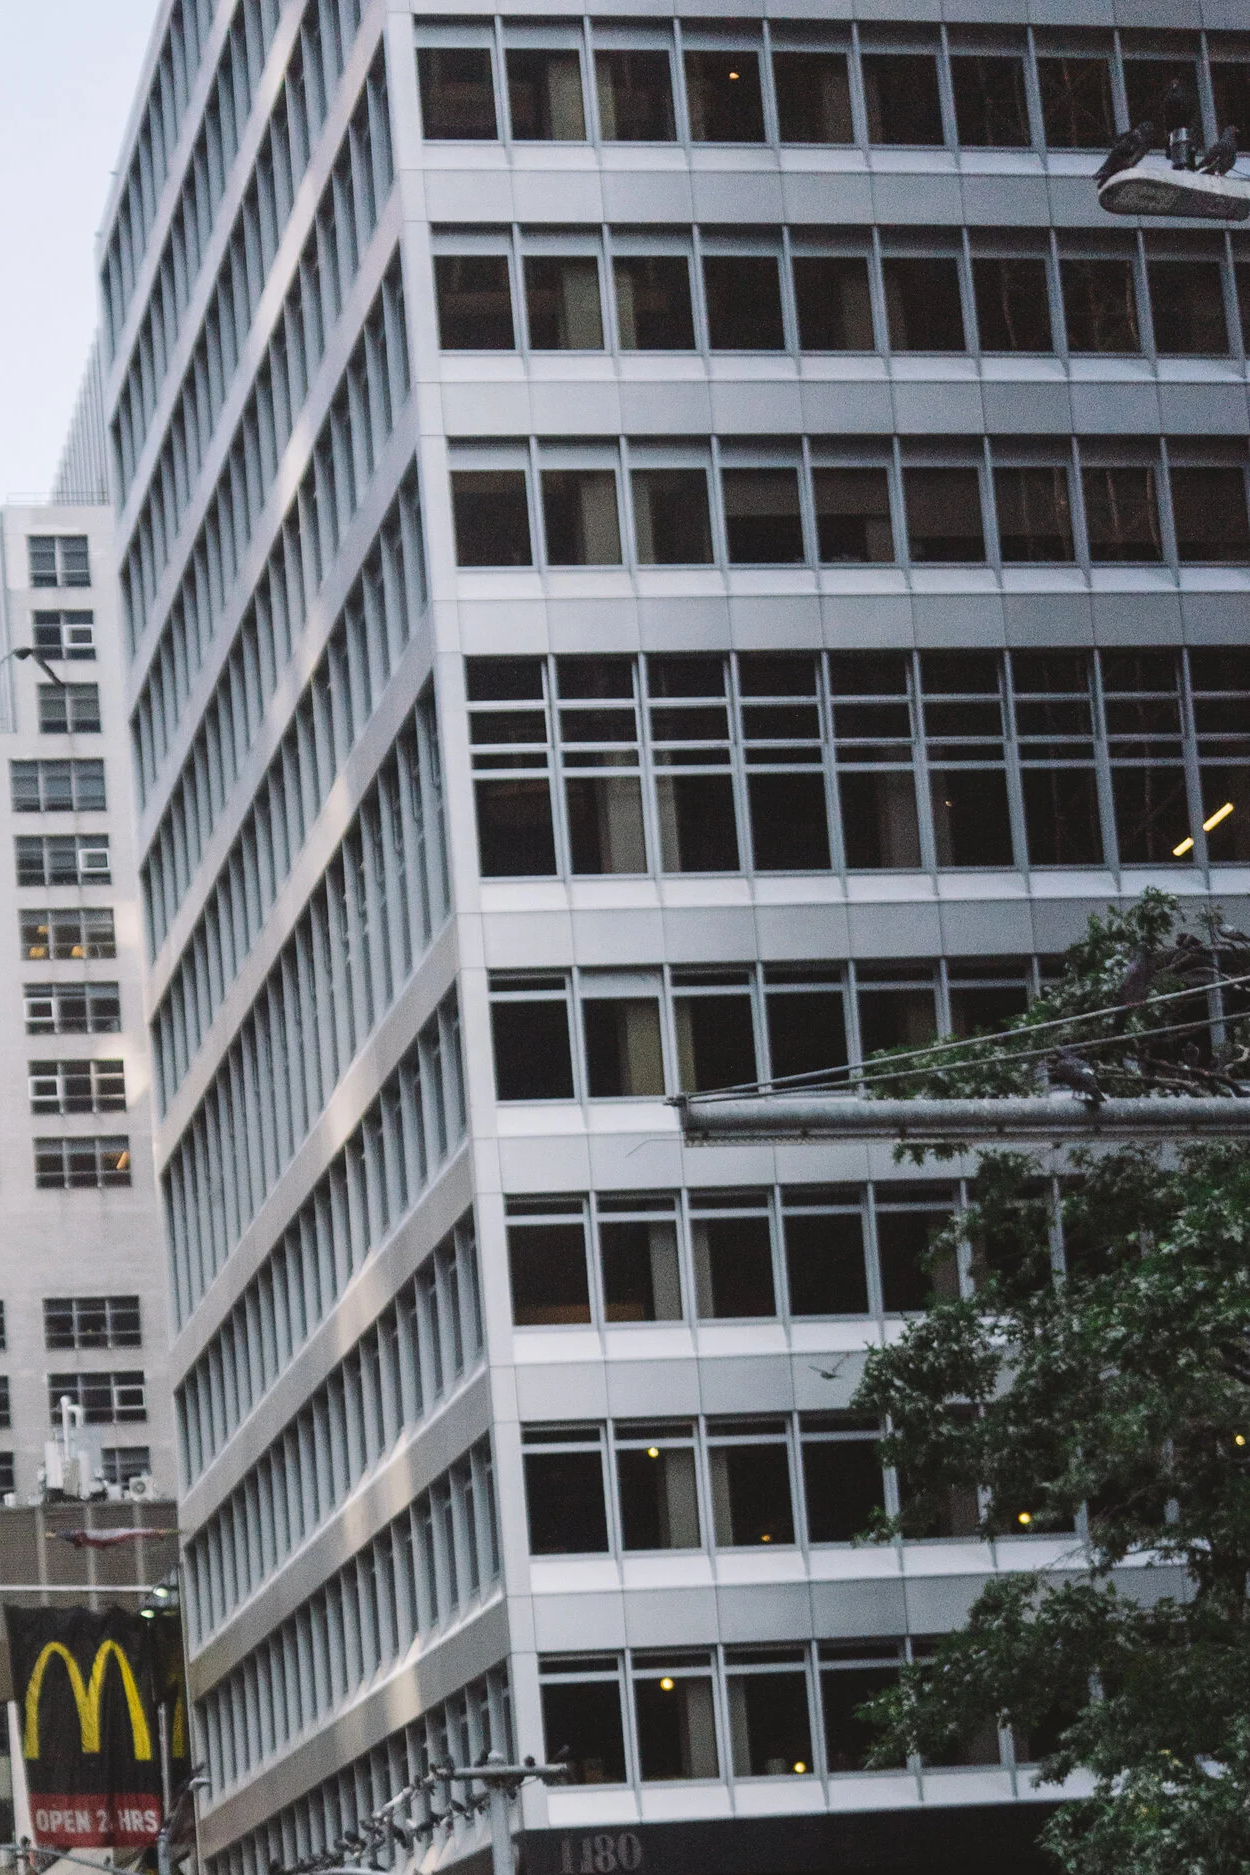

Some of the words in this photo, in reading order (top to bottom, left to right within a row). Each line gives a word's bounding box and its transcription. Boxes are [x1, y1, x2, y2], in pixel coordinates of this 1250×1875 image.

[35, 1808, 92, 1834] OPEN
[96, 1808, 113, 1834] 2
[117, 1808, 160, 1834] HRS
[559, 1831, 642, 1875] 1180
